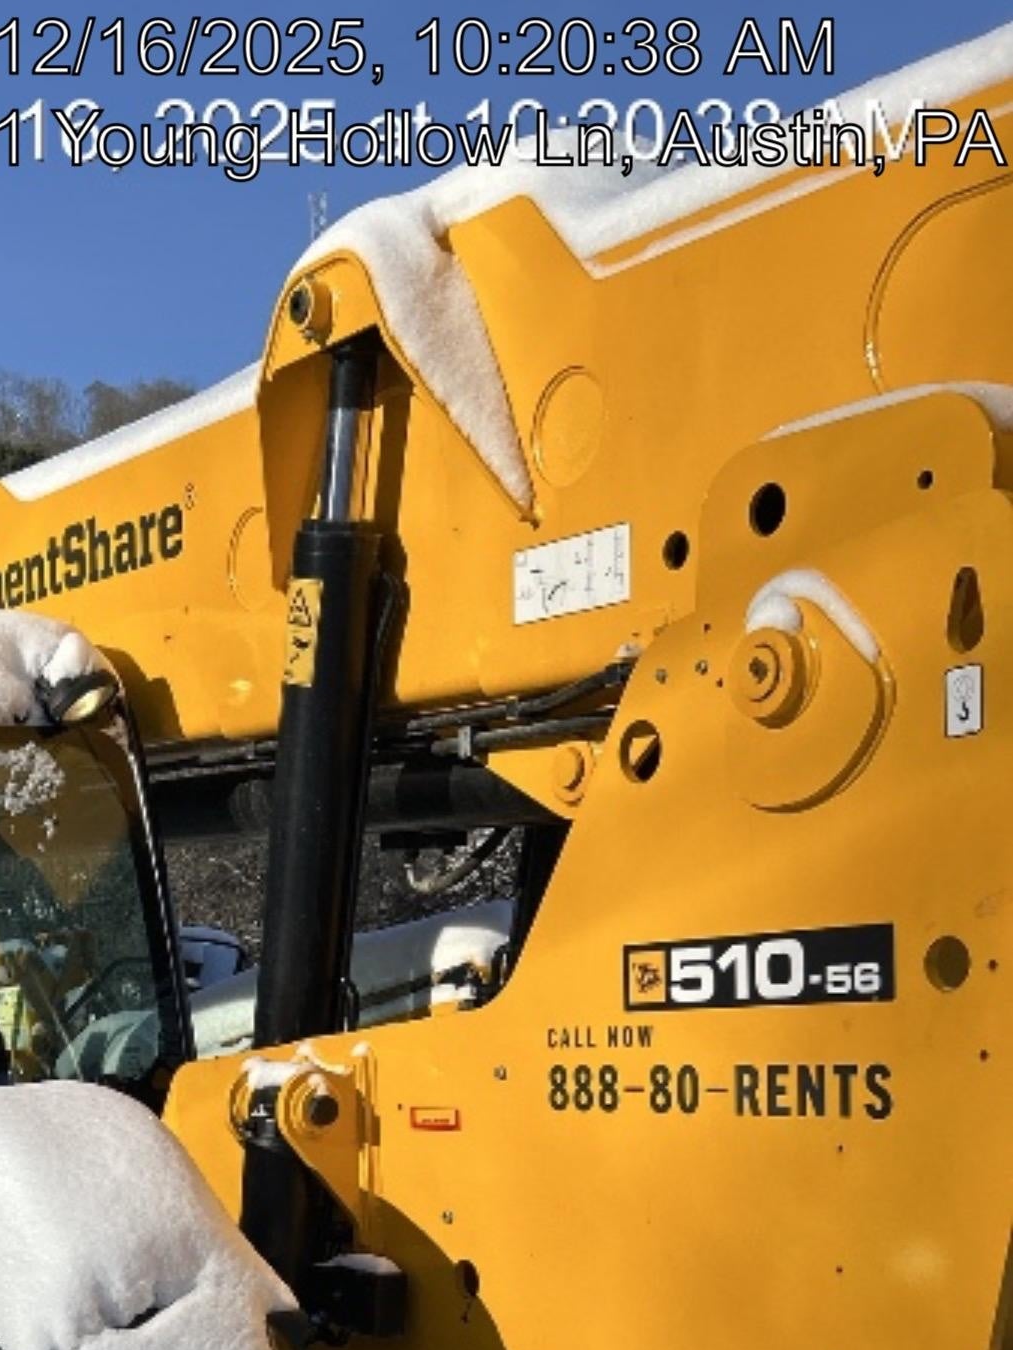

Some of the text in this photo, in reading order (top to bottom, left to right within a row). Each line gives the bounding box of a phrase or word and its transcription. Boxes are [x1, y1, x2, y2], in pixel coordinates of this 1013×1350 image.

[669, 938, 882, 1003] 510-56
[547, 1025, 654, 1049] CALL NOW
[548, 1063, 894, 1120] 888-80-RENTS
